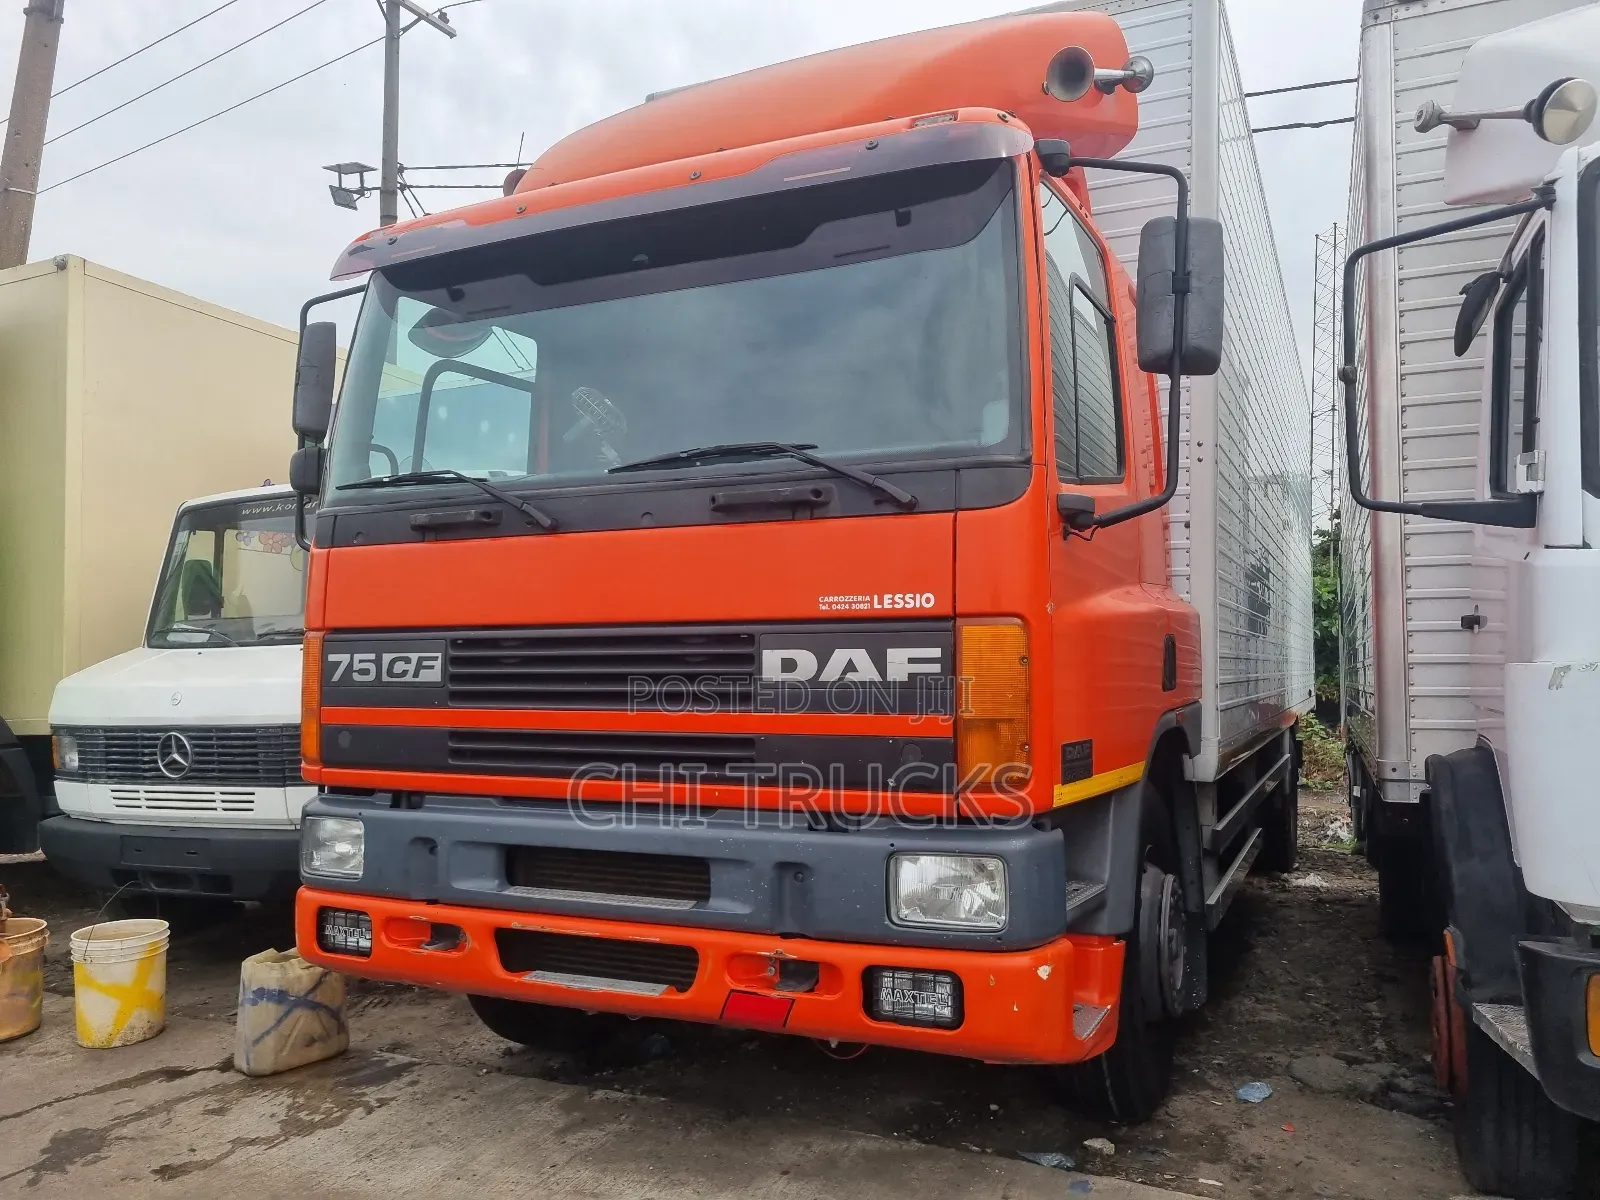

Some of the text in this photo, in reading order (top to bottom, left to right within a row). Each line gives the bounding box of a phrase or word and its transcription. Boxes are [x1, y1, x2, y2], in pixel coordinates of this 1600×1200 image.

[818, 595, 871, 603] CARROZZERIA
[873, 592, 935, 609] LESSIO
[762, 647, 942, 682] DAF
[880, 987, 949, 1007] MAXTEL
